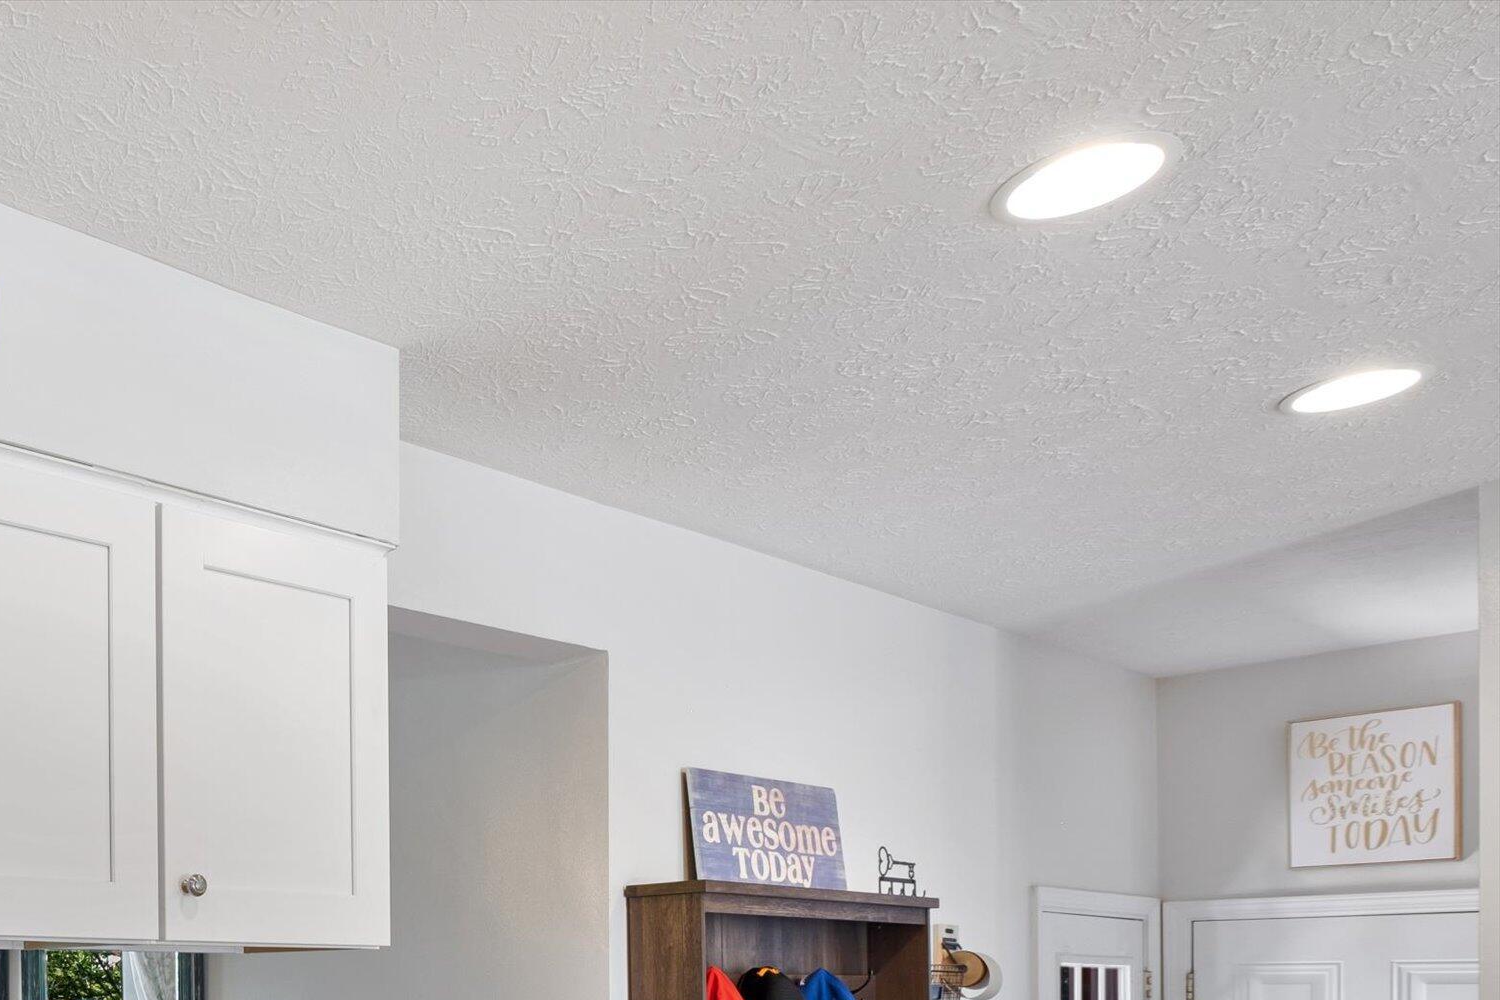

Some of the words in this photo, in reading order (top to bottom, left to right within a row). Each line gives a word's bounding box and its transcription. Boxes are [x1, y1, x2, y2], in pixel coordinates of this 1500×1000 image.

[1297, 731, 1340, 760] Be
[1334, 718, 1390, 752] the
[1326, 735, 1440, 777] REASON
[750, 784, 786, 819] Be
[1301, 770, 1413, 803] someone
[702, 810, 838, 857] awesome
[1322, 807, 1441, 854] TODAY
